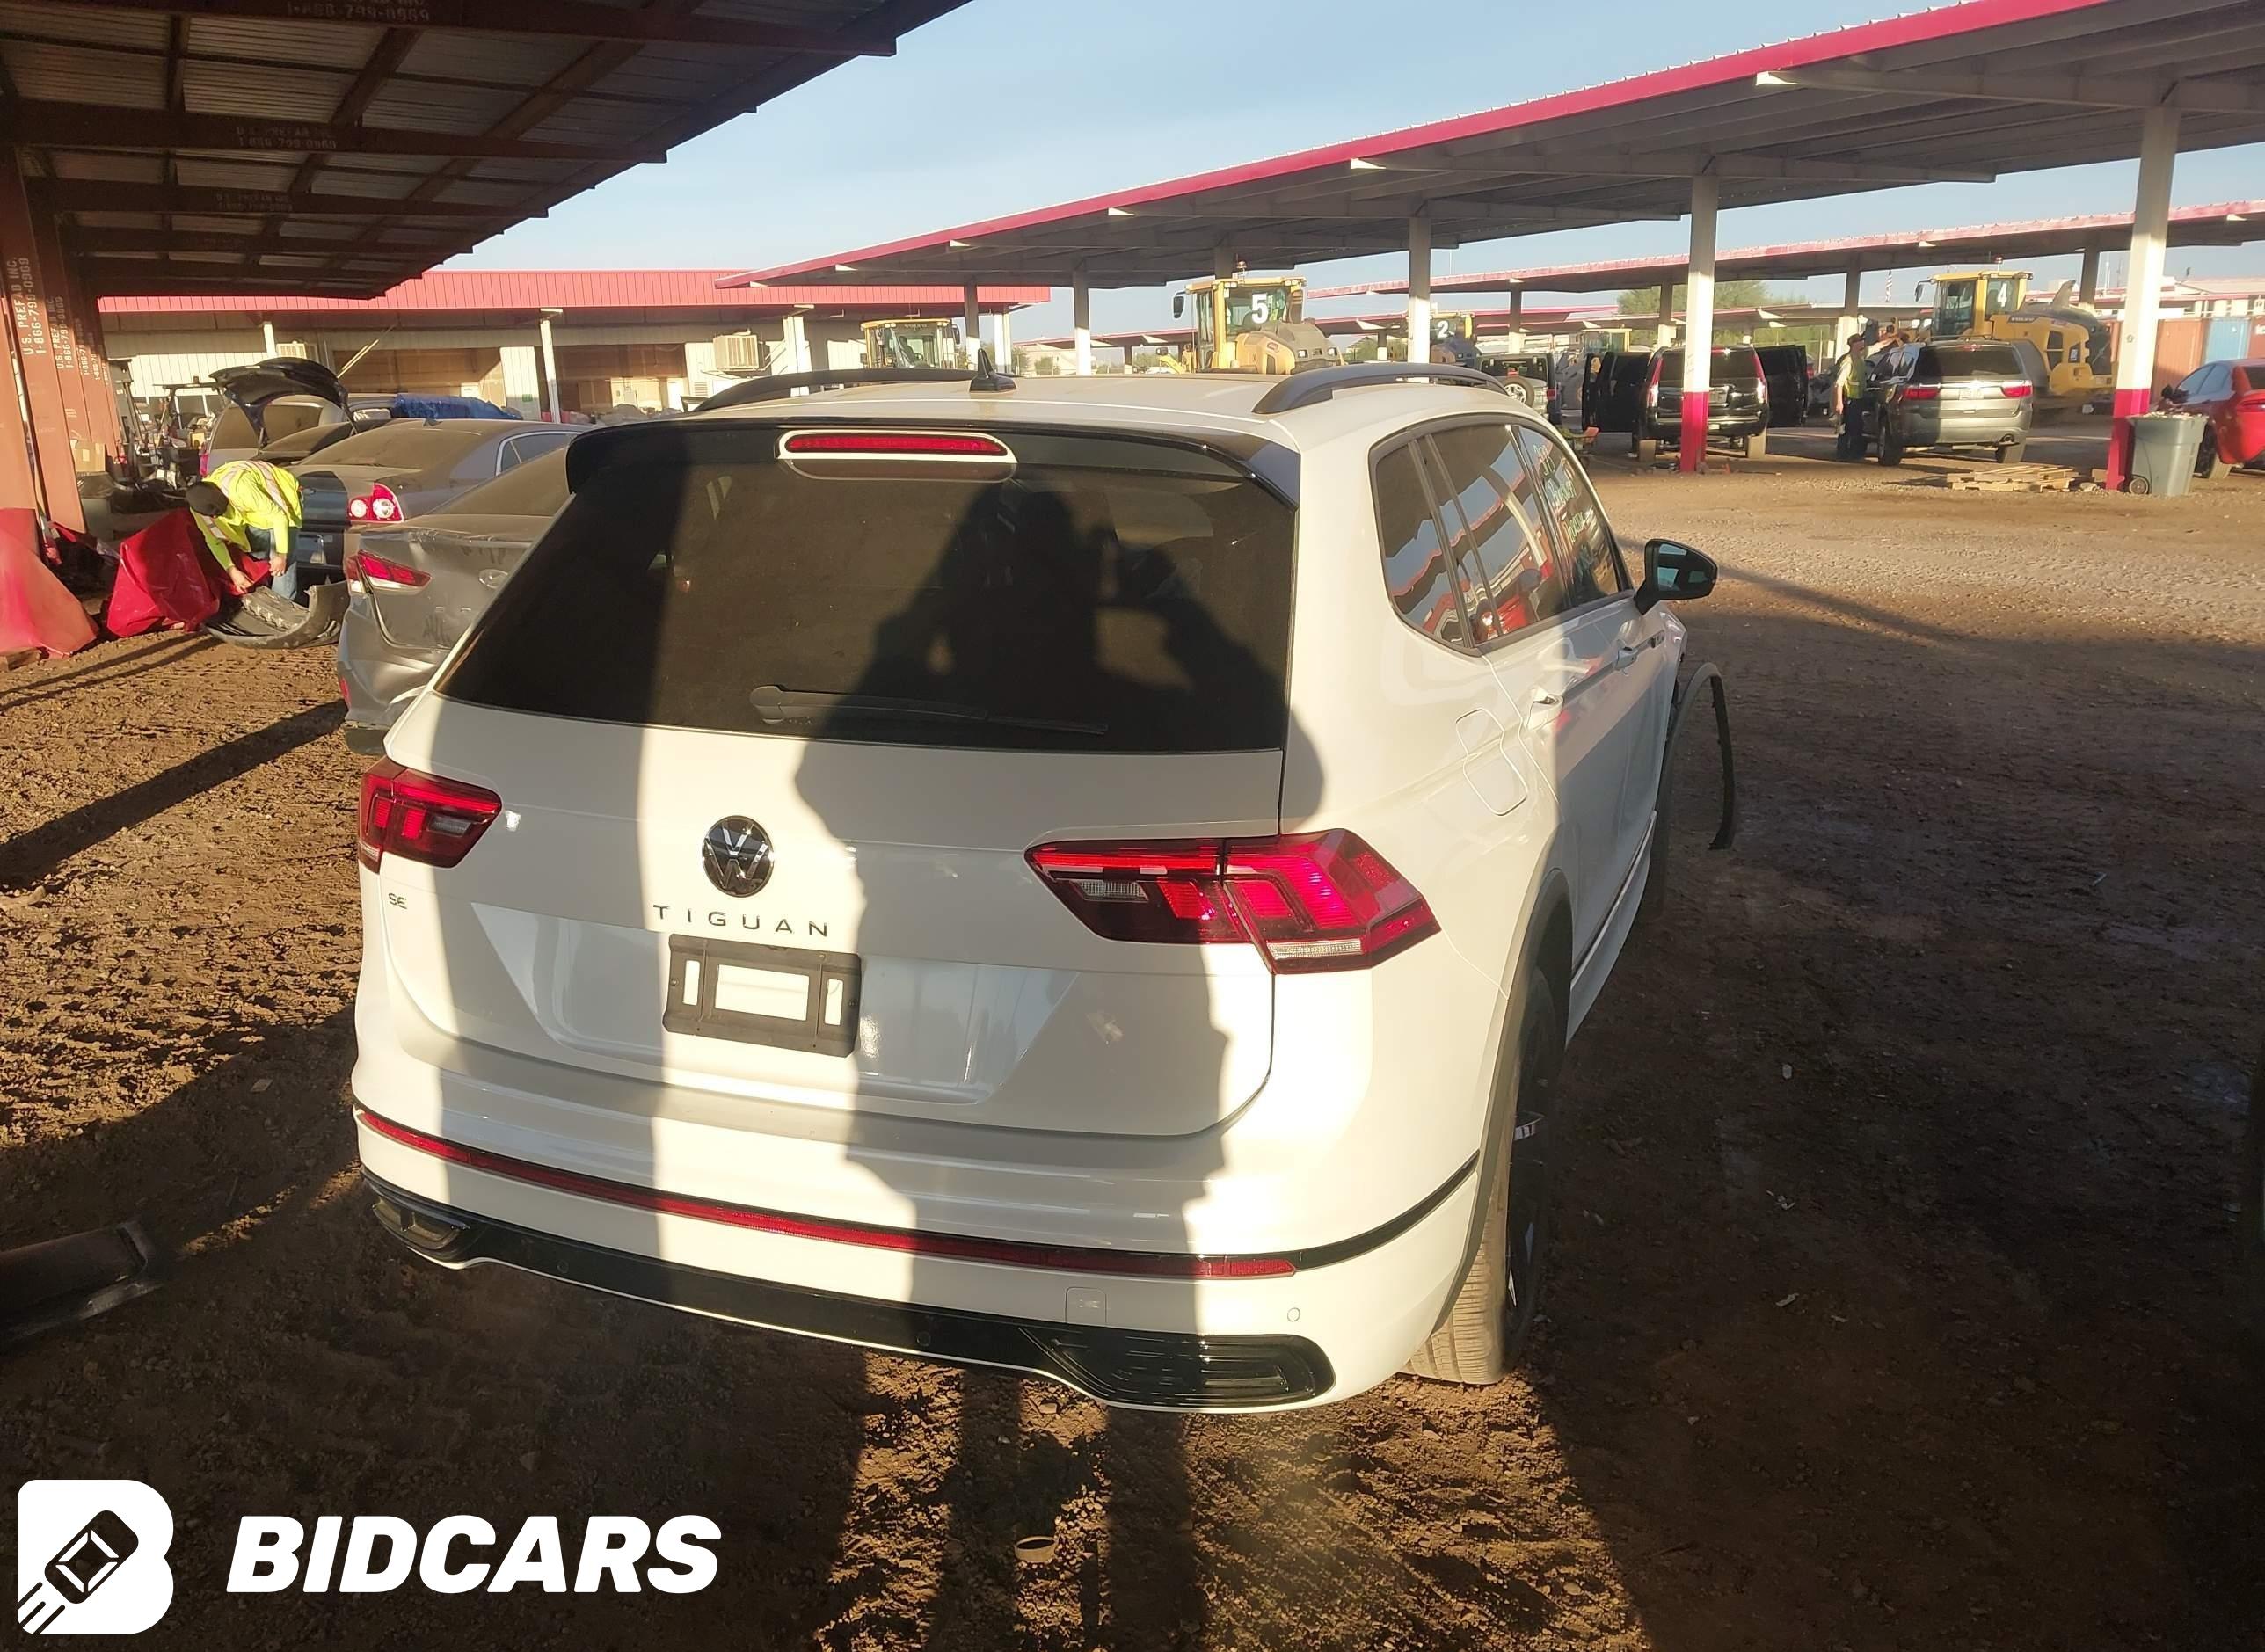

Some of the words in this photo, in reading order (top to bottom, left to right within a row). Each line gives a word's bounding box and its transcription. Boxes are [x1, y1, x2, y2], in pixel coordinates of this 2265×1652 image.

[7, 257, 19, 279] INC.
[11, 284, 29, 328] PREFAB
[1997, 282, 2008, 308] 4
[1252, 293, 1270, 324] 5
[1437, 321, 1450, 338] 2
[22, 334, 34, 355] U.S.
[388, 892, 408, 910] SE
[652, 904, 828, 938] TIGUAN
